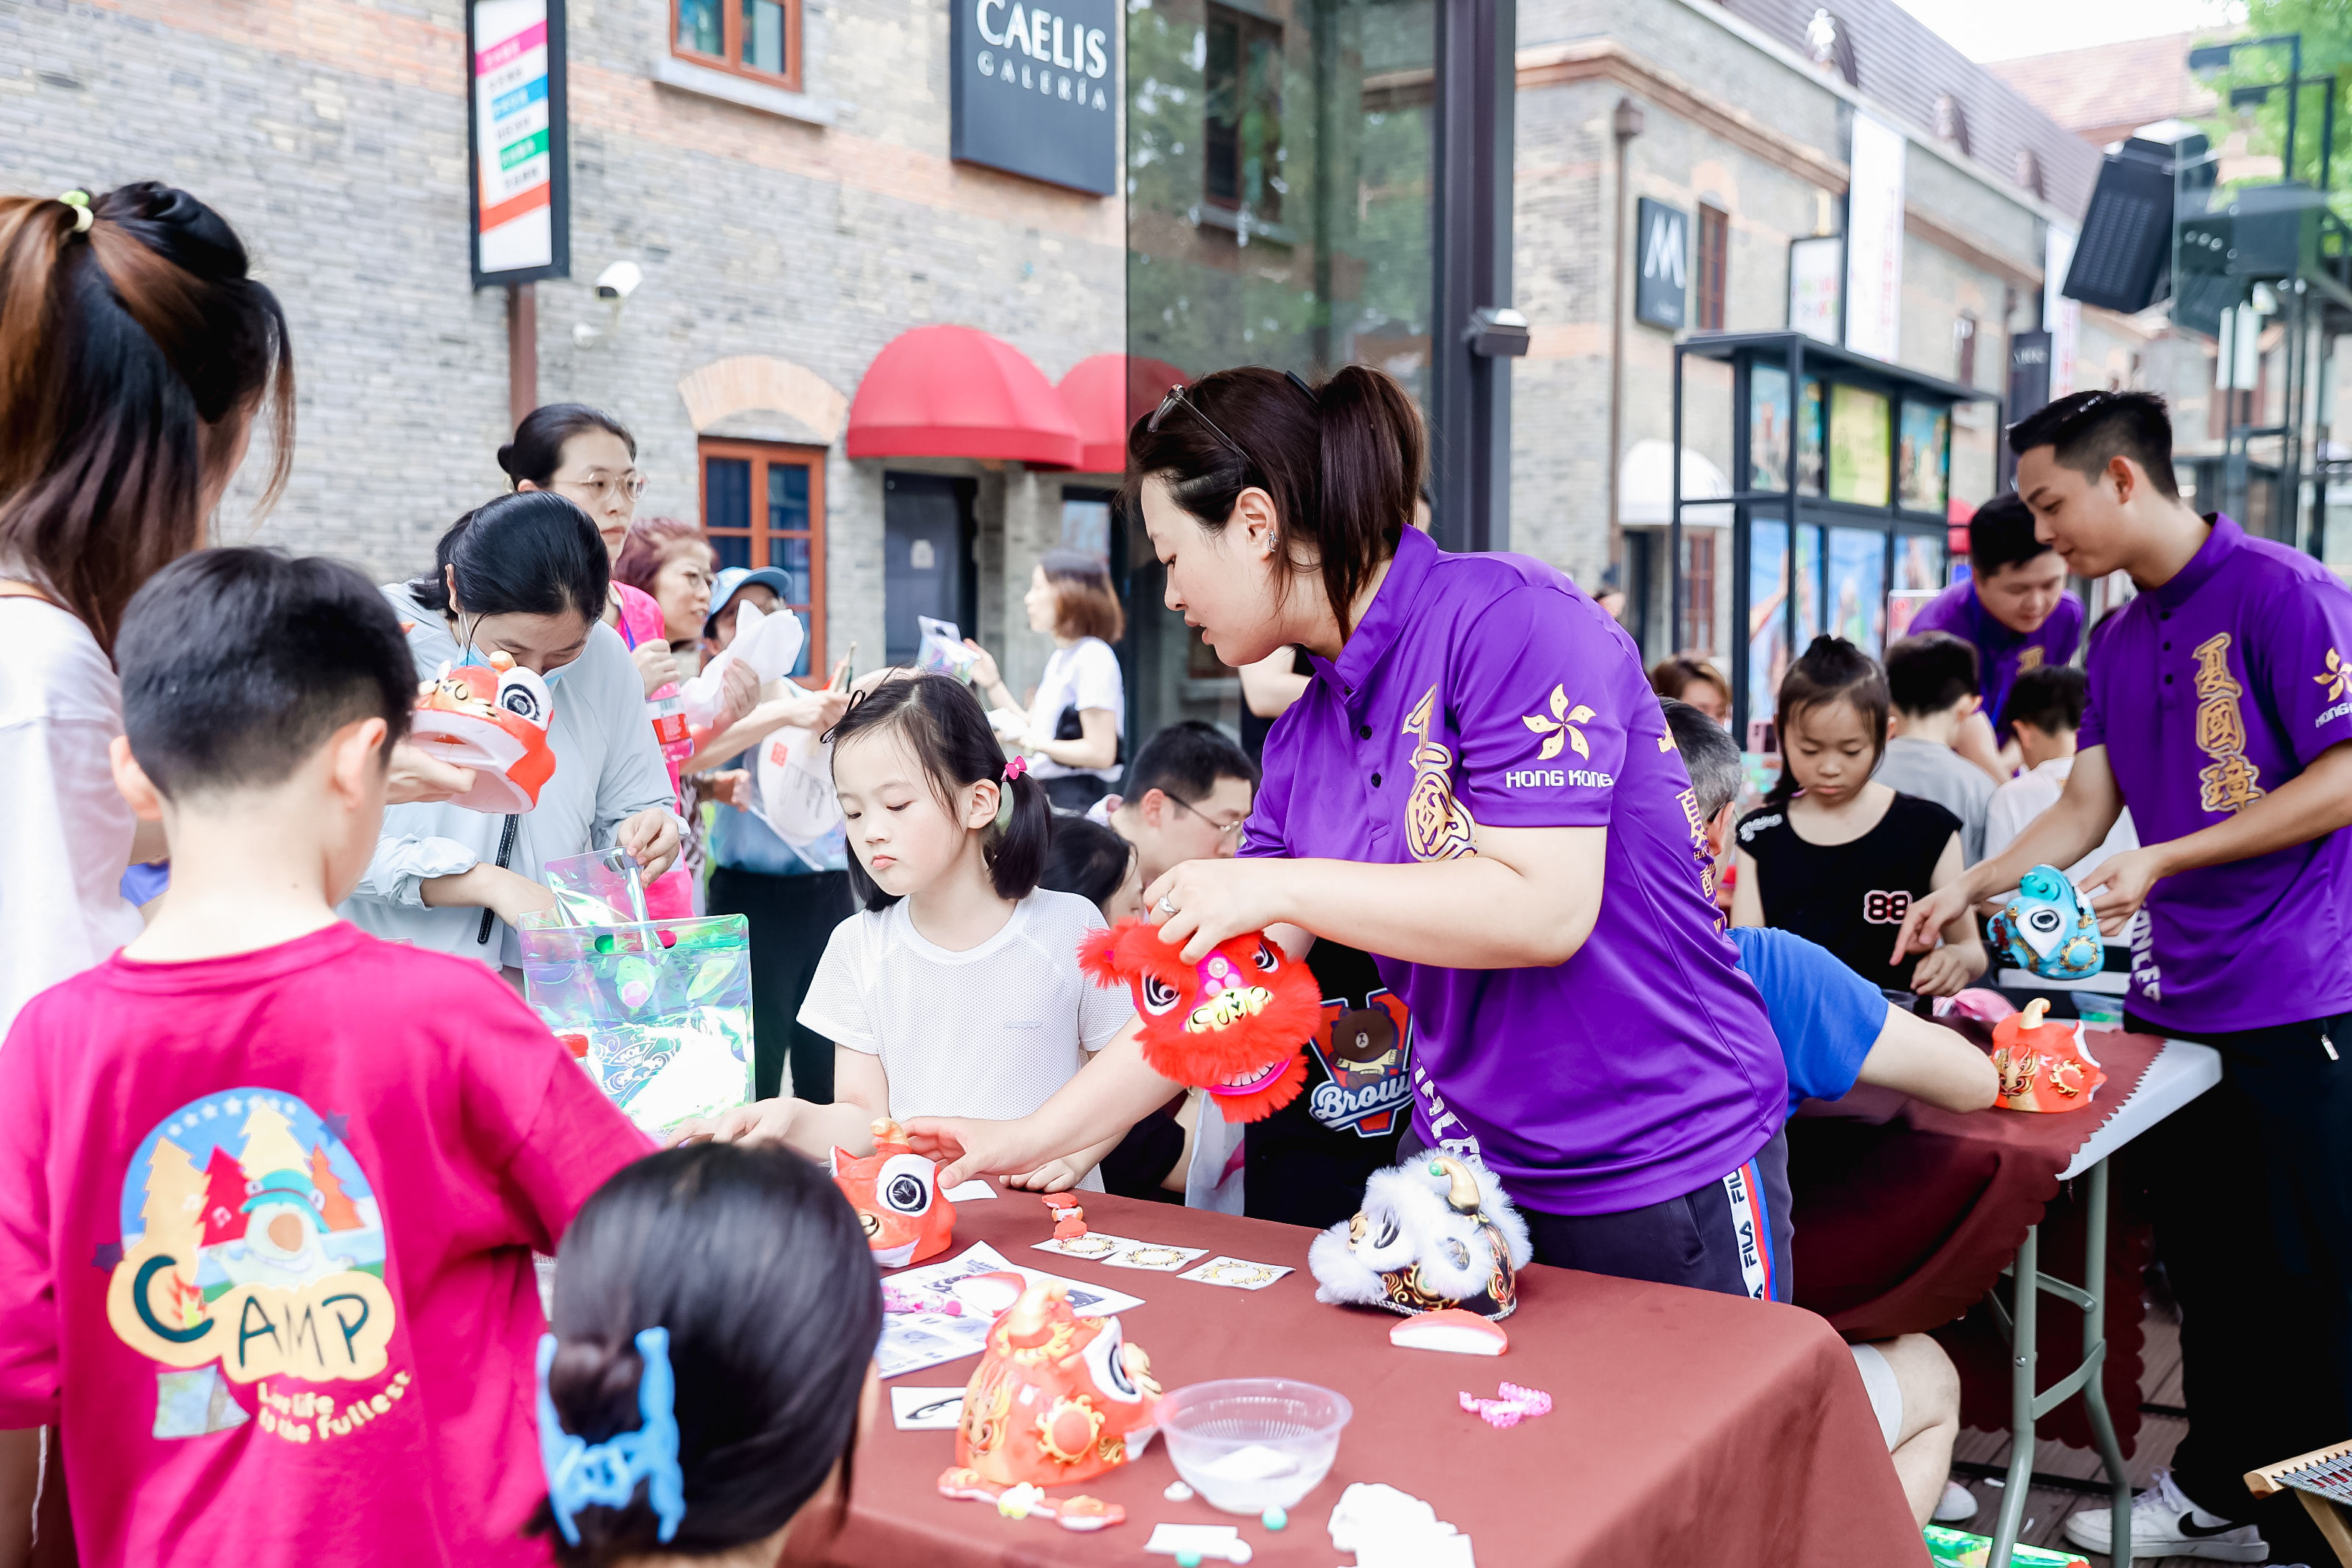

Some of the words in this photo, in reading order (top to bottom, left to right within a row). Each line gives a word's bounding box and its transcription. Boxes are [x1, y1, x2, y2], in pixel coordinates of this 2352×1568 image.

[976, 0, 1107, 79] CAELIS
[1643, 211, 1687, 289] M
[1506, 770, 1565, 789] HONG
[1568, 769, 1614, 789] KONG
[1865, 890, 1912, 924] 88
[1739, 1220, 1757, 1268] FILA
[134, 1254, 369, 1368] CAMP
